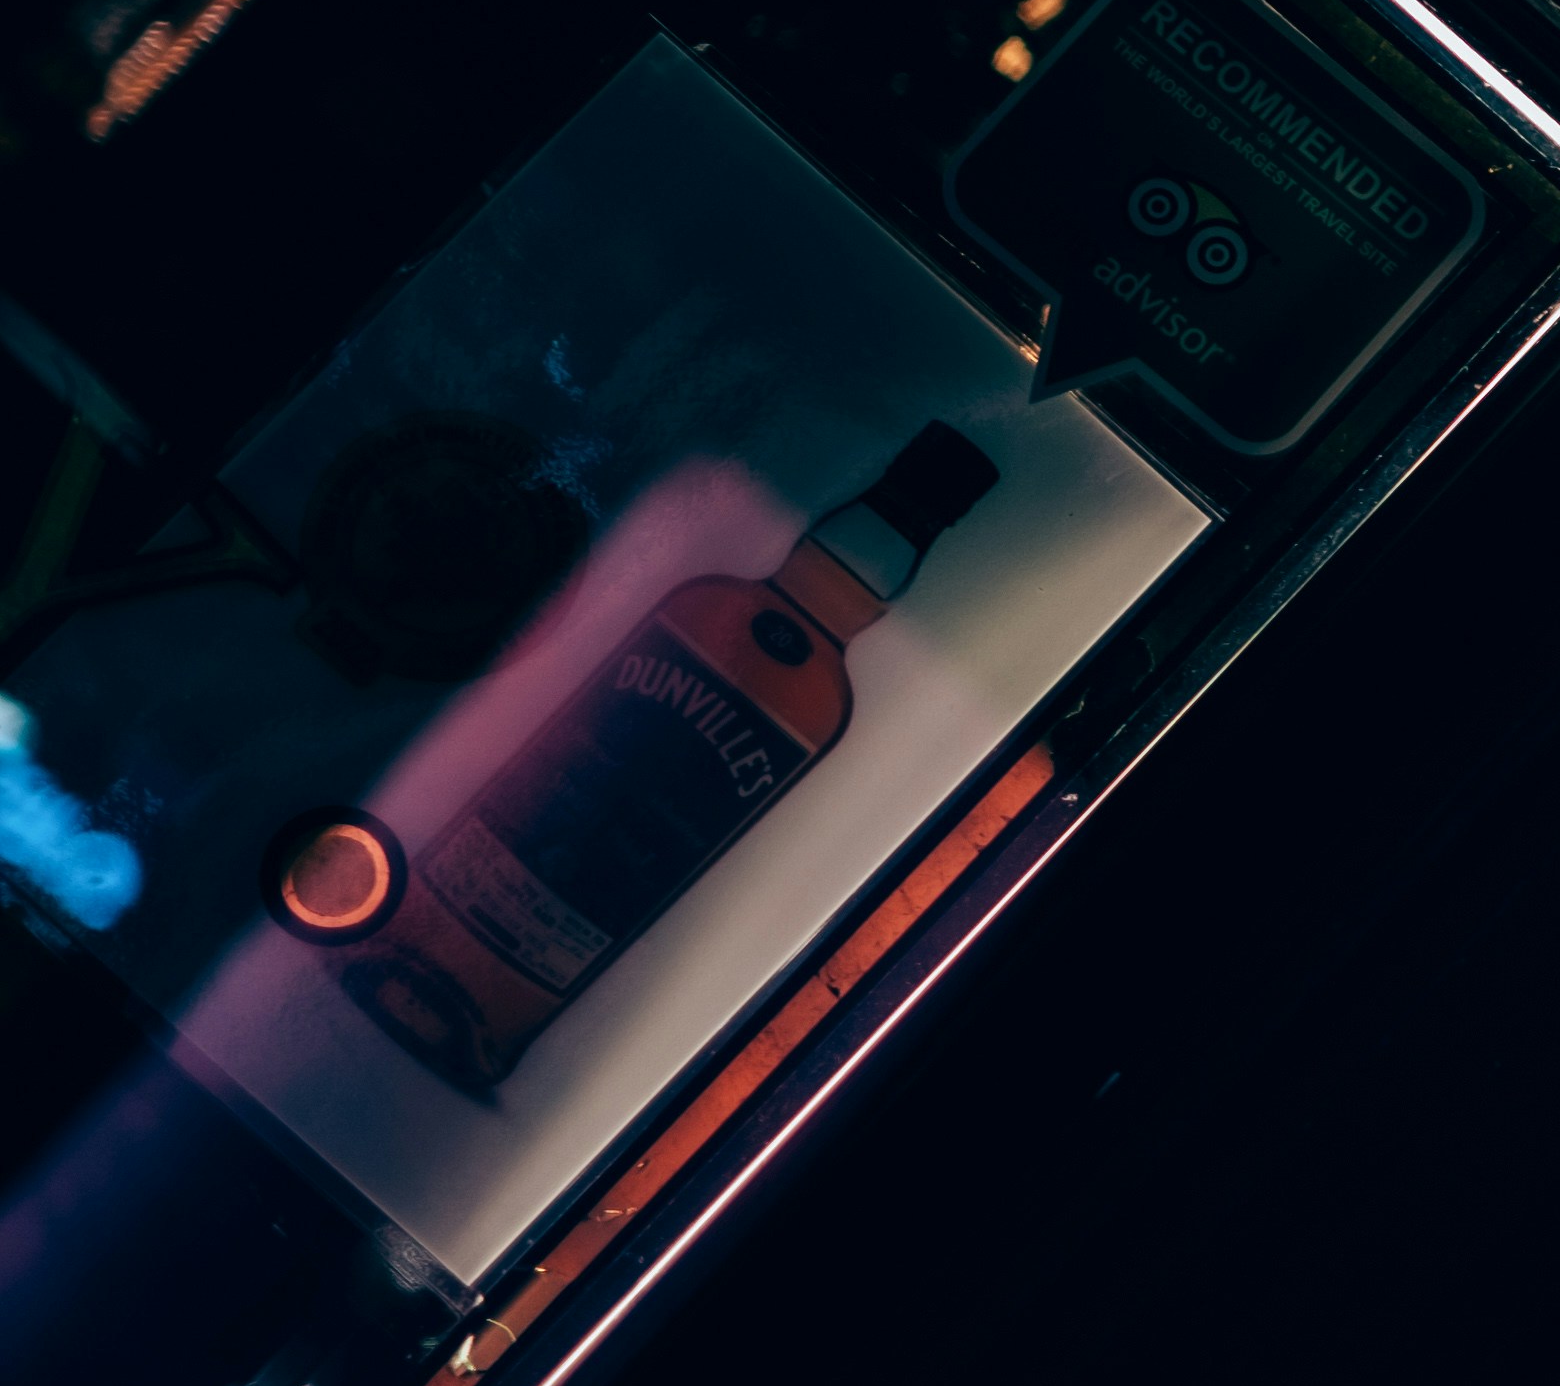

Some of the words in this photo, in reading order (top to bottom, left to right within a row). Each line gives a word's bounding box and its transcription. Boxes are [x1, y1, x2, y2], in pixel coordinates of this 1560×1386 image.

[1114, 38, 1149, 74] THE
[1145, 64, 1224, 131] WORLD'S
[1221, 125, 1298, 193] LARGEST
[1297, 187, 1361, 245] TRAVEL
[1359, 235, 1398, 276] SITE
[615, 653, 778, 801] DUNVILLE'S
